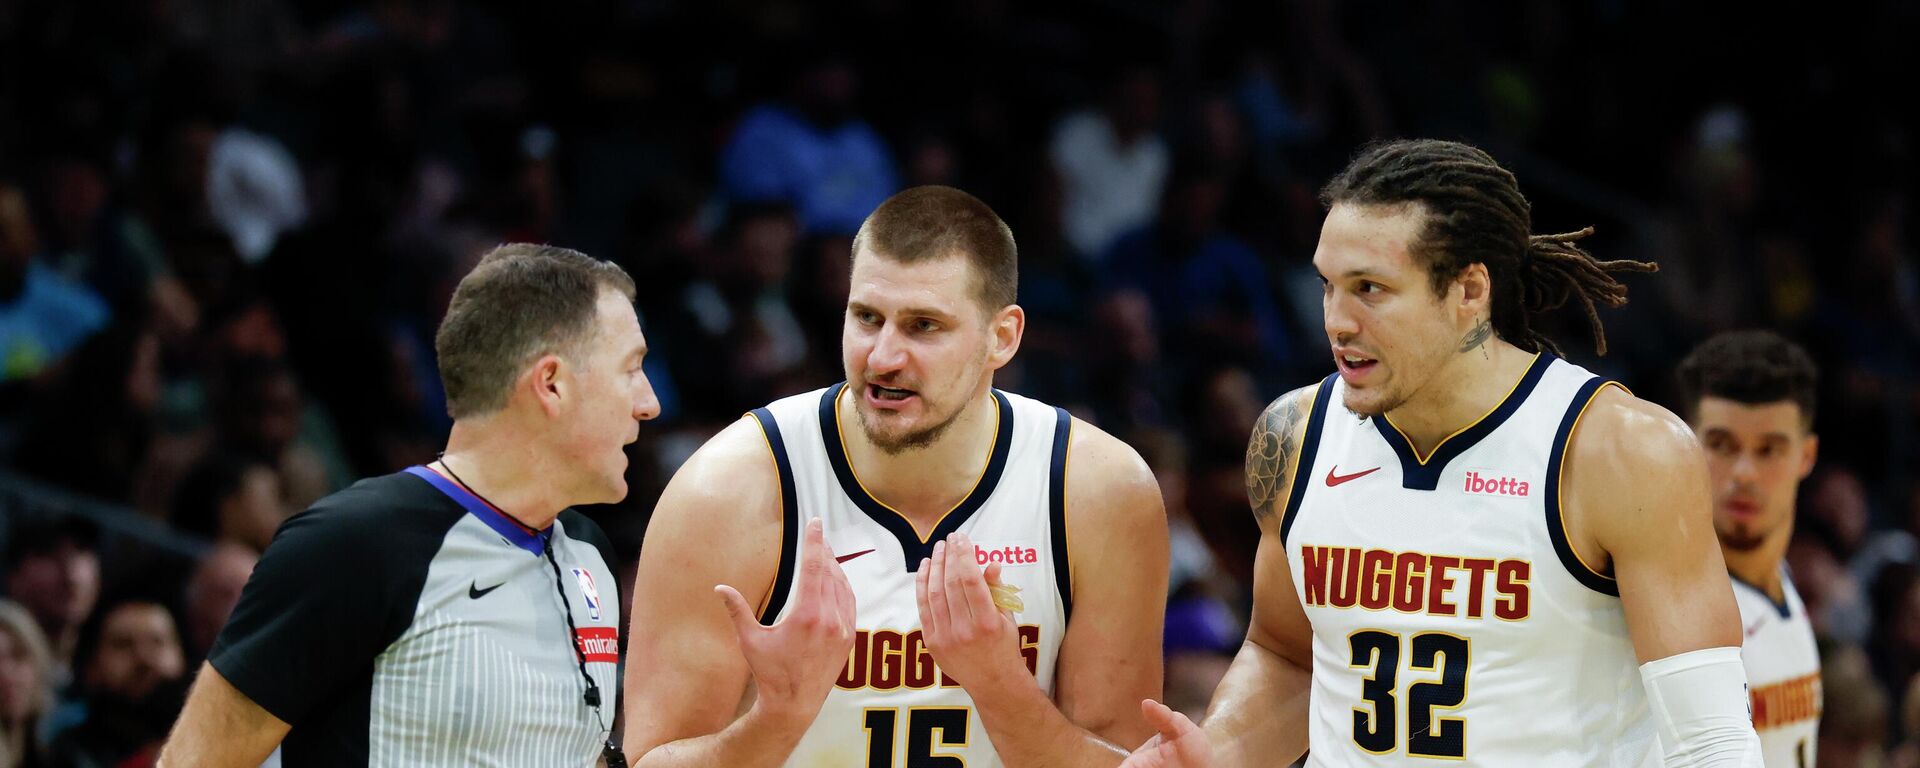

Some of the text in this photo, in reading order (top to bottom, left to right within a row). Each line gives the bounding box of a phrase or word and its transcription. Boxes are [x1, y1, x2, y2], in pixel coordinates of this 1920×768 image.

[1465, 472, 1529, 496] ibotta
[975, 545, 1037, 565] botta
[1301, 545, 1531, 620] NUGGETS
[1347, 629, 1471, 760] 32
[862, 706, 972, 768] 15
